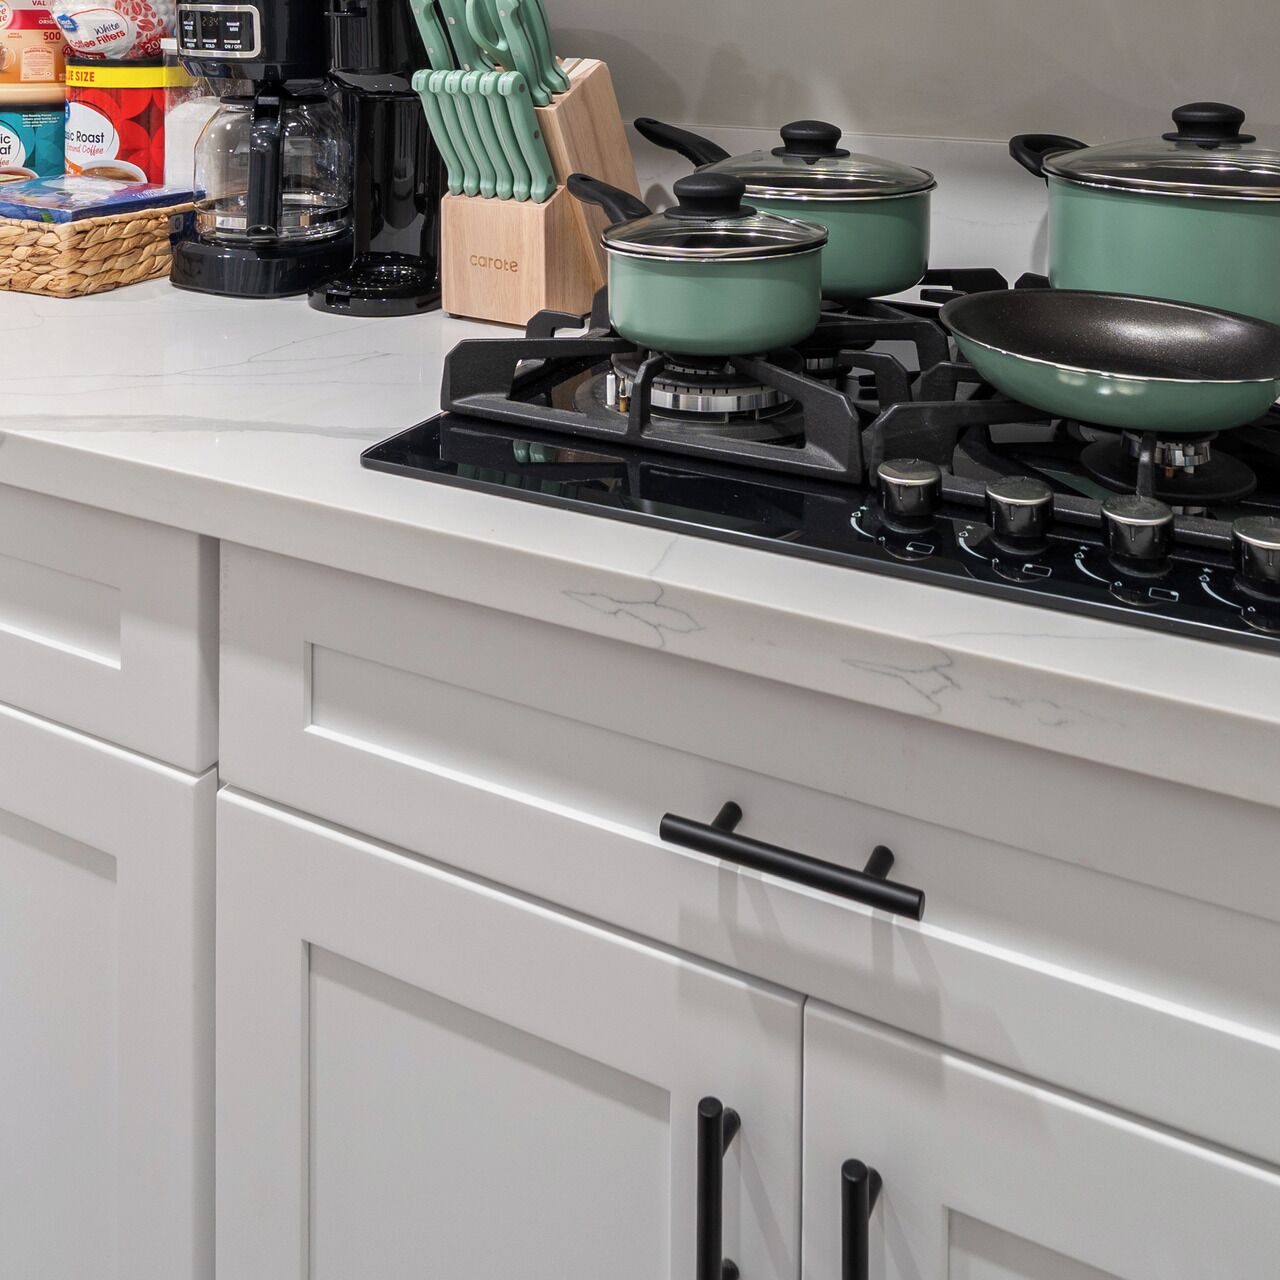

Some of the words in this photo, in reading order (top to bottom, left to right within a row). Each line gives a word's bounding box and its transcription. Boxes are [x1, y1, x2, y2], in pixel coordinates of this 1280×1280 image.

[94, 21, 120, 35] White
[43, 31, 62, 41] 500
[96, 30, 126, 44] Filters
[145, 38, 161, 52] 20
[75, 71, 95, 82] SIZE
[76, 130, 105, 143] Roast
[82, 144, 104, 156] Coffee
[469, 254, 518, 273] carote
